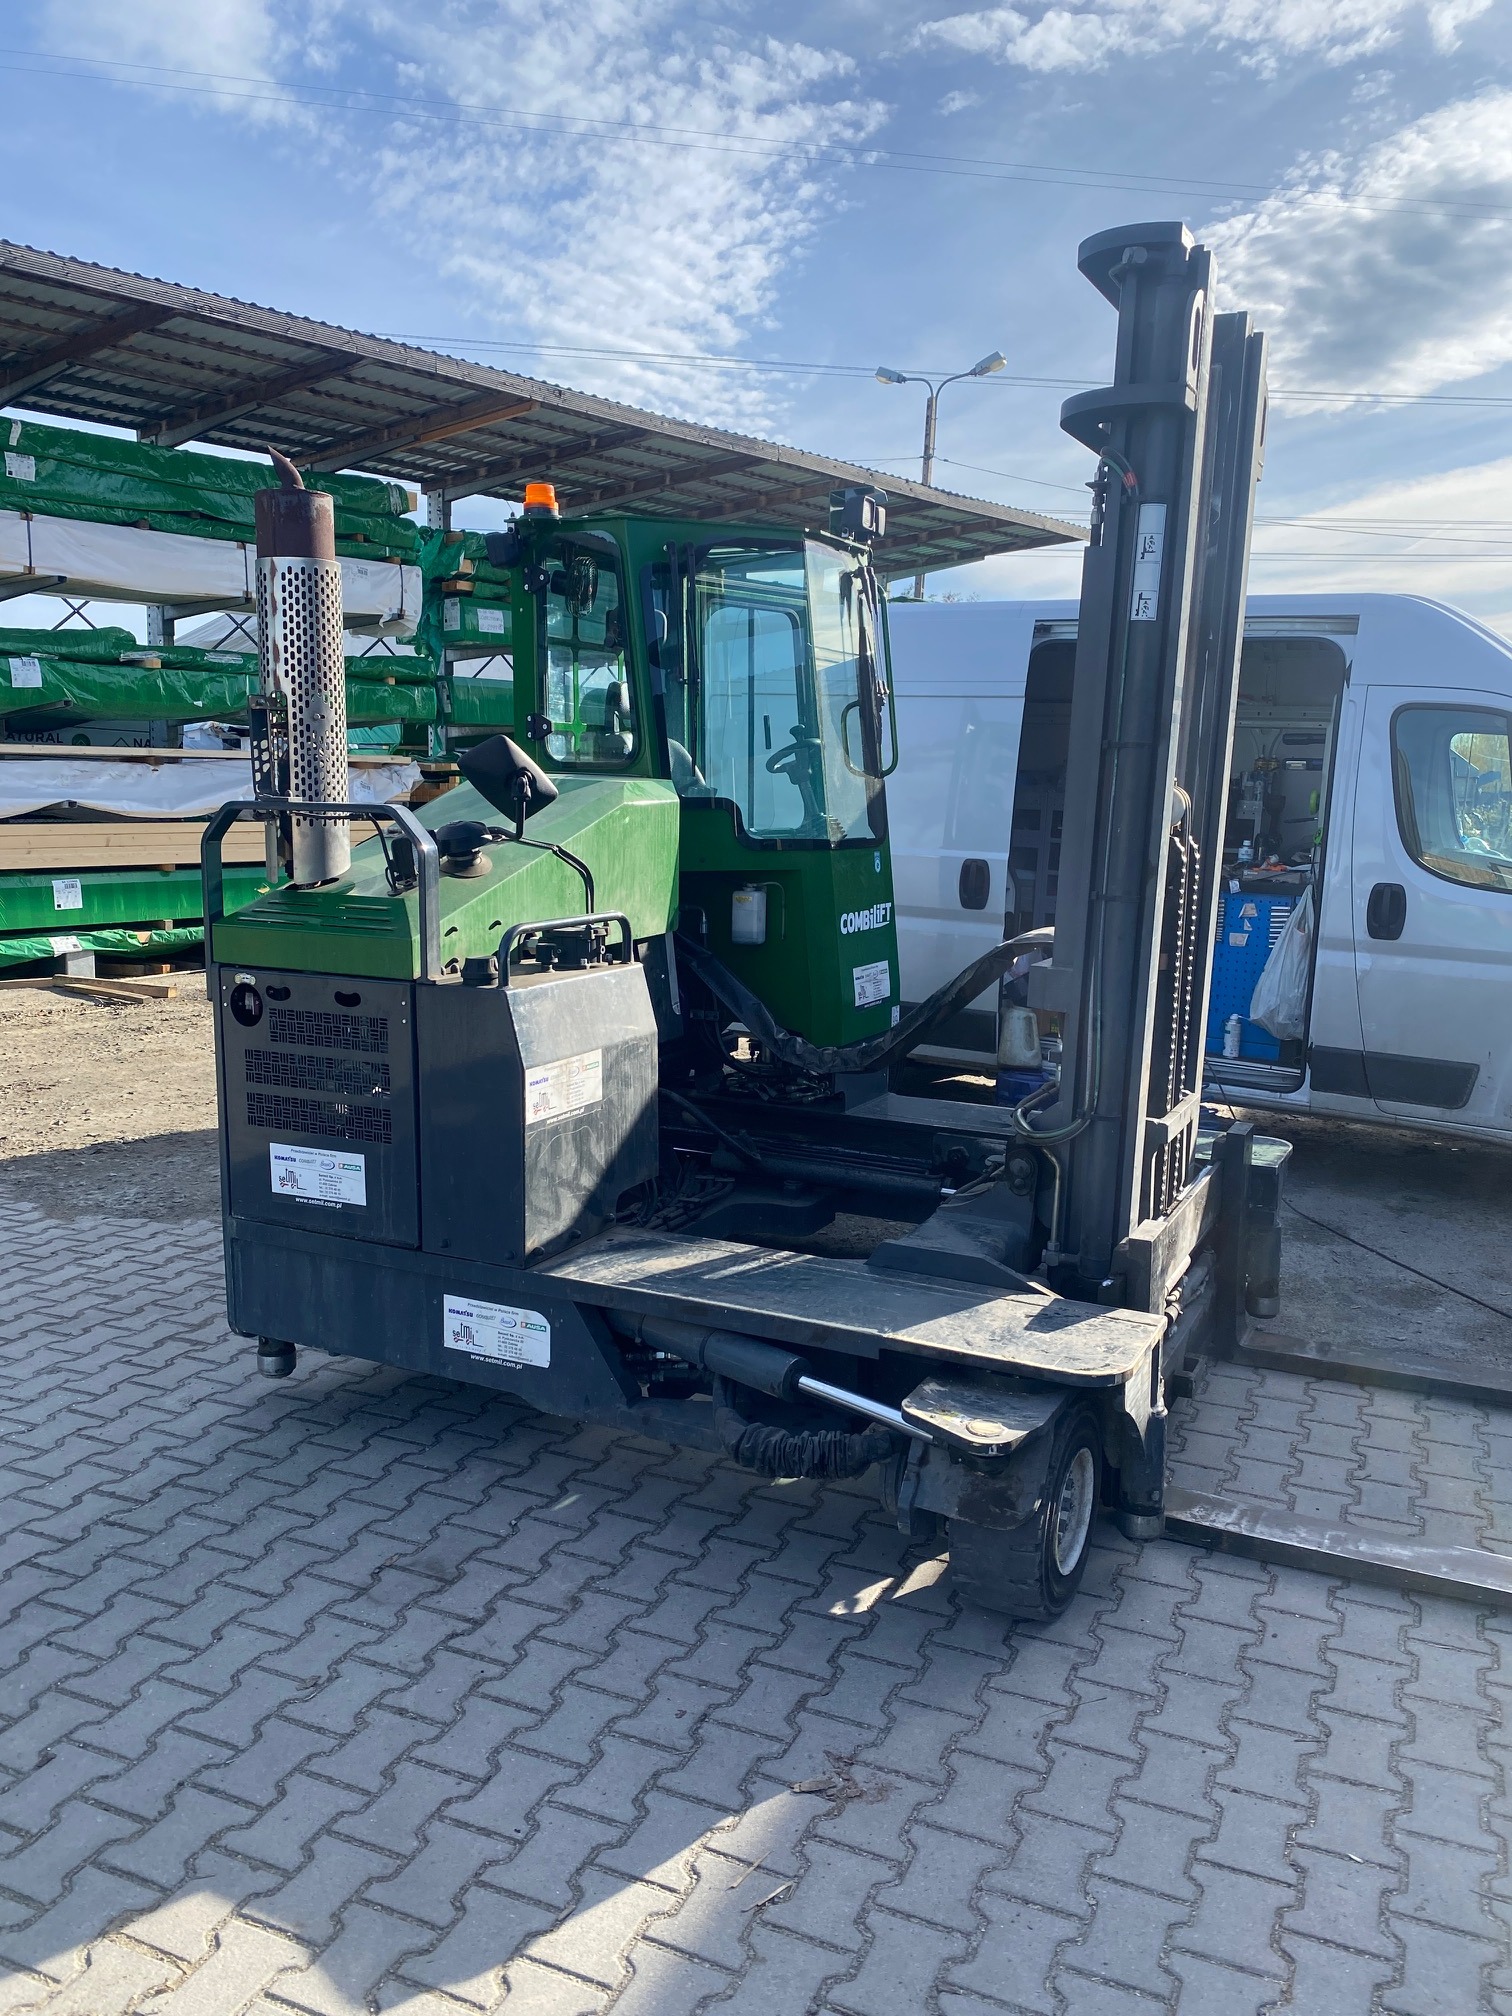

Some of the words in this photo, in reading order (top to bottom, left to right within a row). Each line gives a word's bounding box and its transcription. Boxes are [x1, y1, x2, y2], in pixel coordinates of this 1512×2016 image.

[273, 1154, 297, 1163] KOMATSU
[295, 1197, 342, 1209] www.setmil.com.pl
[448, 1308, 474, 1318] KOMATSU
[526, 1323, 546, 1331] AUSA
[470, 1354, 523, 1370] www.setmil.com.pl
